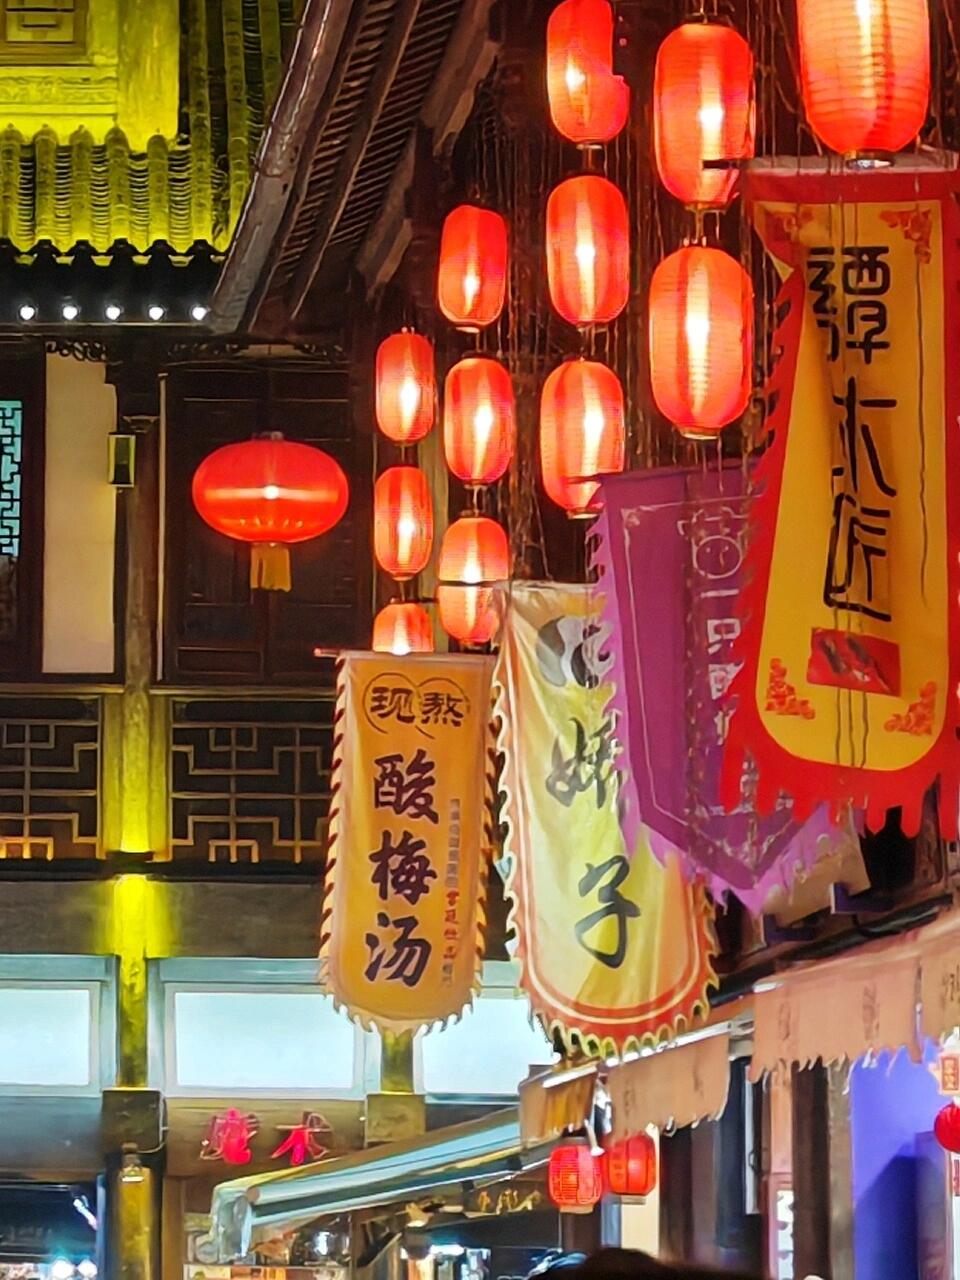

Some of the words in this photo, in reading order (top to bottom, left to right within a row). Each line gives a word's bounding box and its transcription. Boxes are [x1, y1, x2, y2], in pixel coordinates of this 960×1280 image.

[369, 685, 466, 728] 现熬
[364, 748, 440, 988] 酸梅汤
